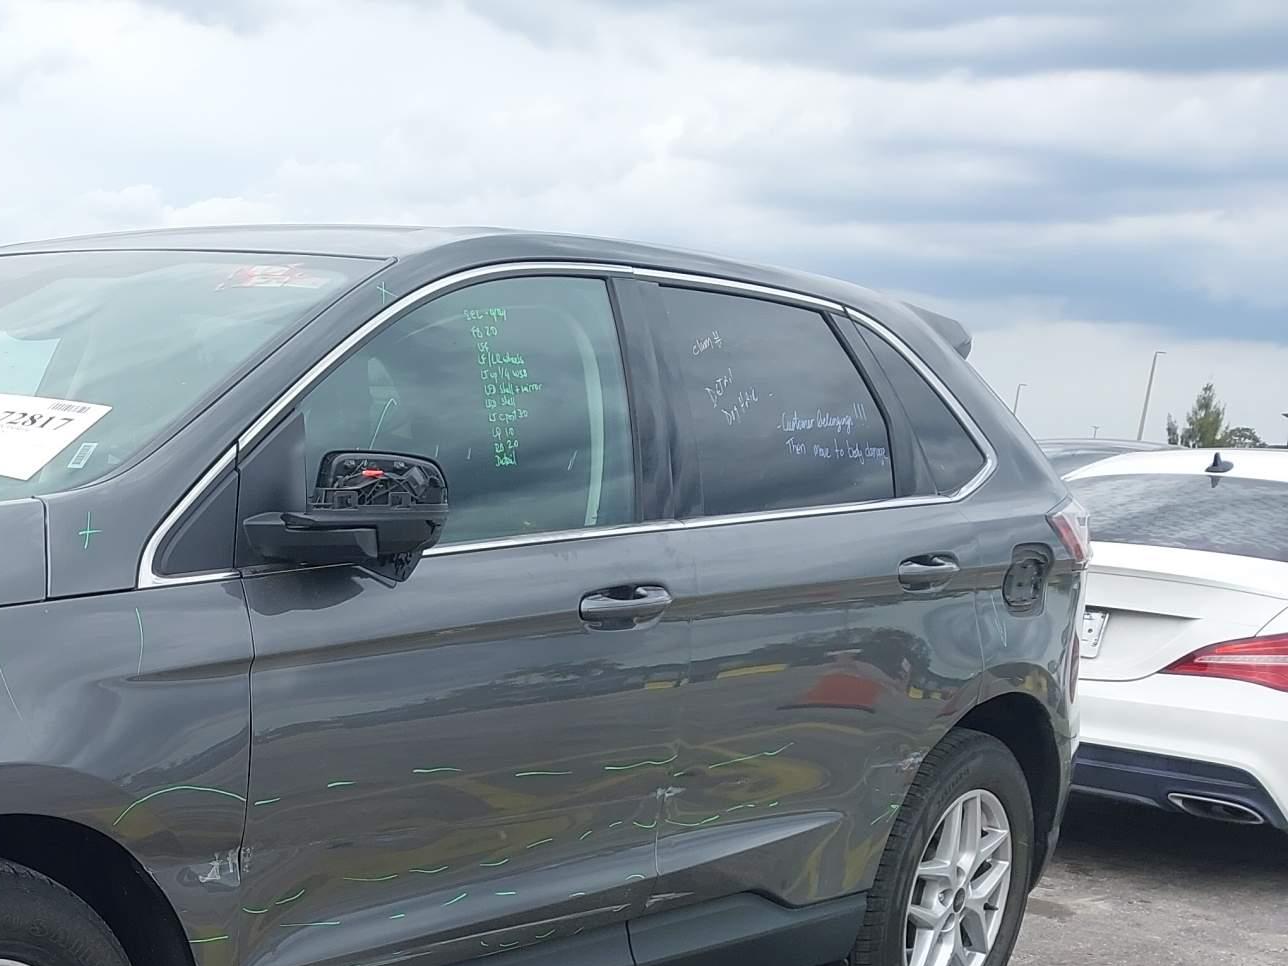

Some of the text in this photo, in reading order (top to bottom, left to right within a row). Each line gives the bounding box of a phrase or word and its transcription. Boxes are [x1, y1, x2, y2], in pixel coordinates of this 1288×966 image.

[521, 383, 543, 393] mirror
[786, 437, 807, 455] Then
[834, 438, 844, 459] to
